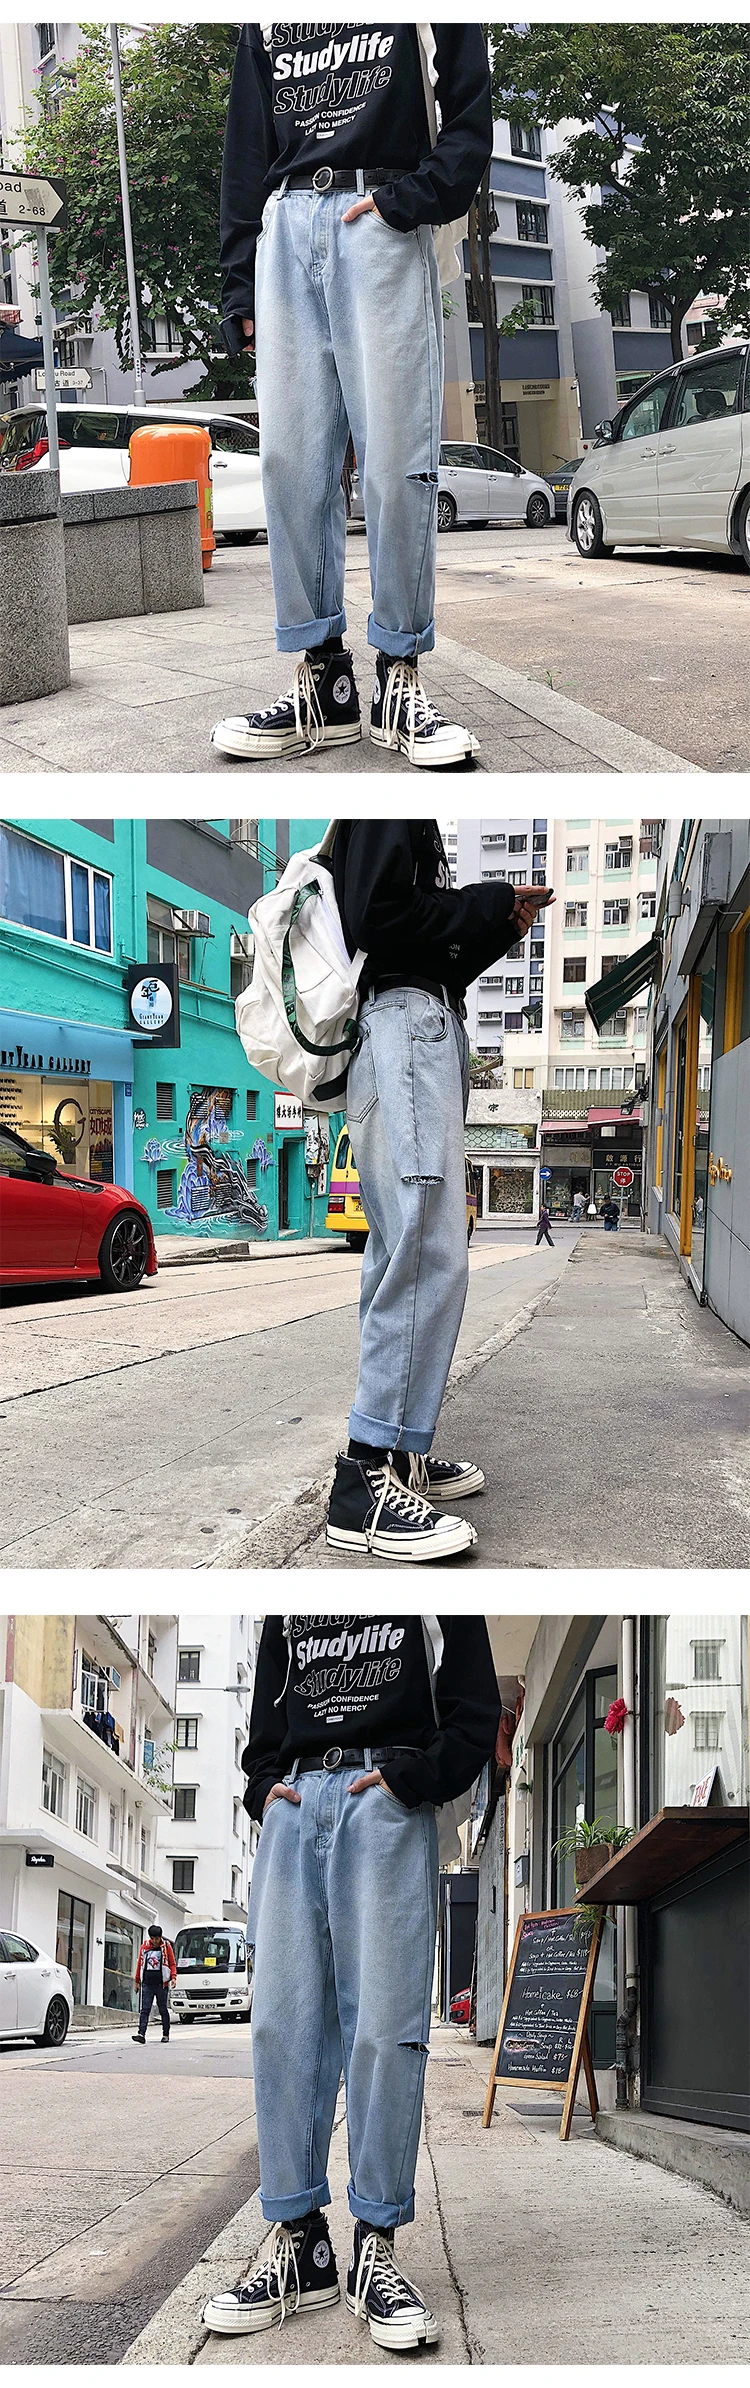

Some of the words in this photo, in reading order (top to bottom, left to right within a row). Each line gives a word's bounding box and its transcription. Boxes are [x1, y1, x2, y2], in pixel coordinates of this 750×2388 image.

[273, 31, 394, 80] Studylife
[274, 65, 392, 114] Studylife
[320, 101, 367, 118] CONFIDENCE
[318, 121, 330, 129] NO
[331, 114, 356, 127] MERCY
[19, 204, 46, 216] 2-68
[49, 1056, 92, 1074] GALLERY
[296, 1623, 405, 1670] Studylife
[294, 1657, 402, 1698] Studylife
[330, 1694, 380, 1703] CONFIDENCE
[328, 1705, 339, 1714] NO
[340, 1704, 367, 1712] MERCY
